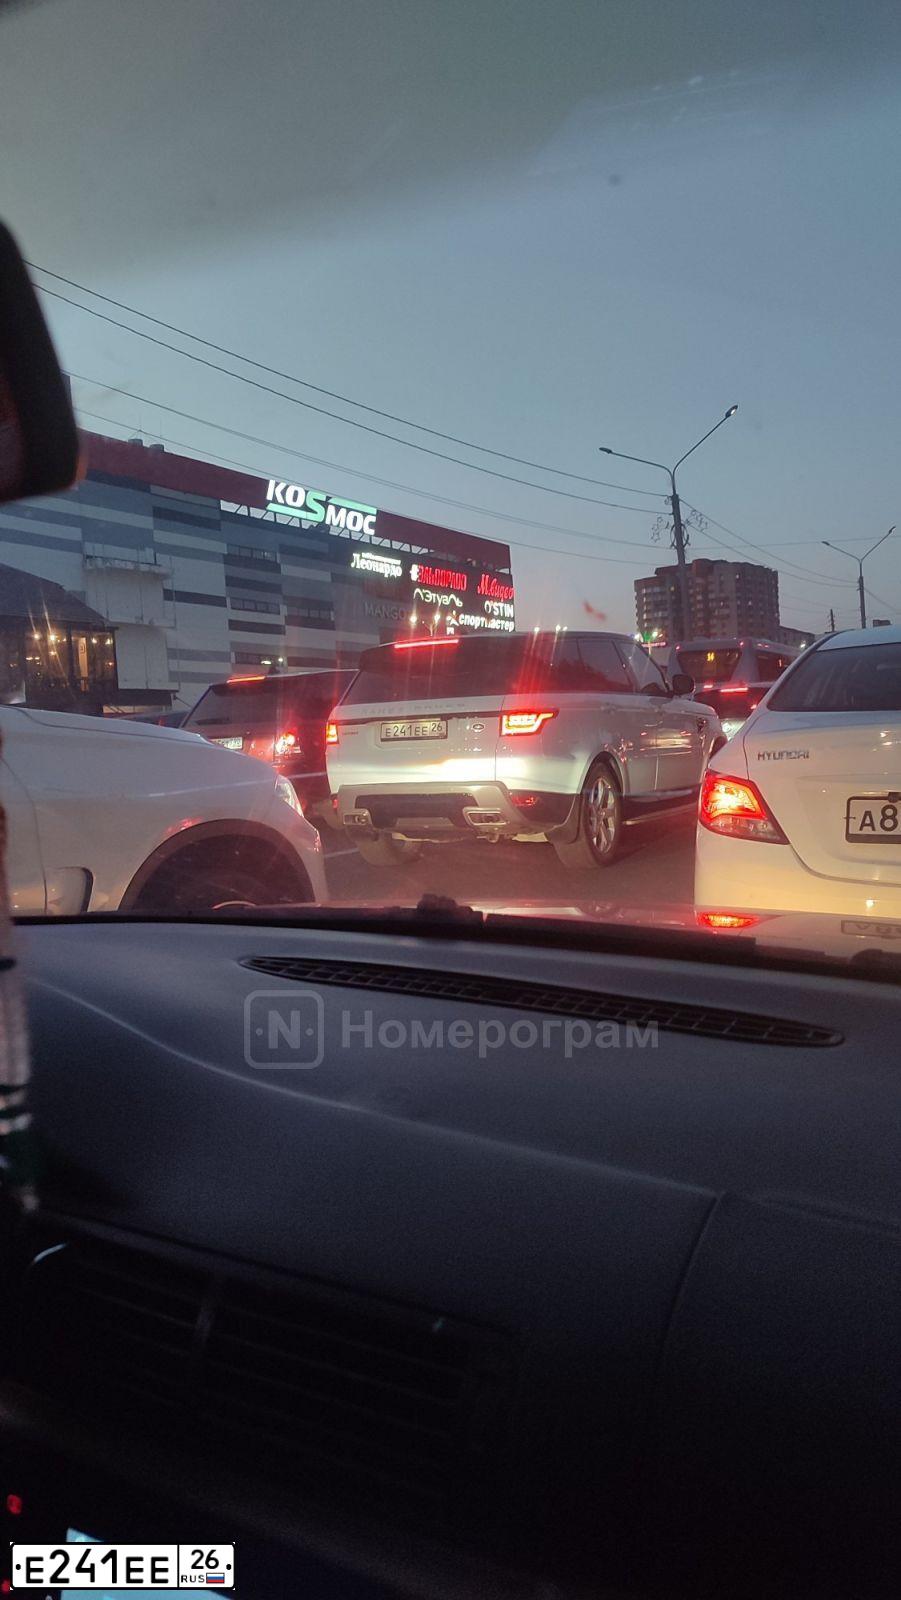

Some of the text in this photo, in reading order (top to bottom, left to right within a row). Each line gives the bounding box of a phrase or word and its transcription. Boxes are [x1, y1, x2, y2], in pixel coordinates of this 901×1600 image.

[350, 553, 402, 578] Леонардо
[363, 601, 406, 620] MANGO
[484, 600, 514, 618] O'STIN
[385, 723, 443, 737] E241EE 26
[757, 750, 809, 761] HYUNDAI
